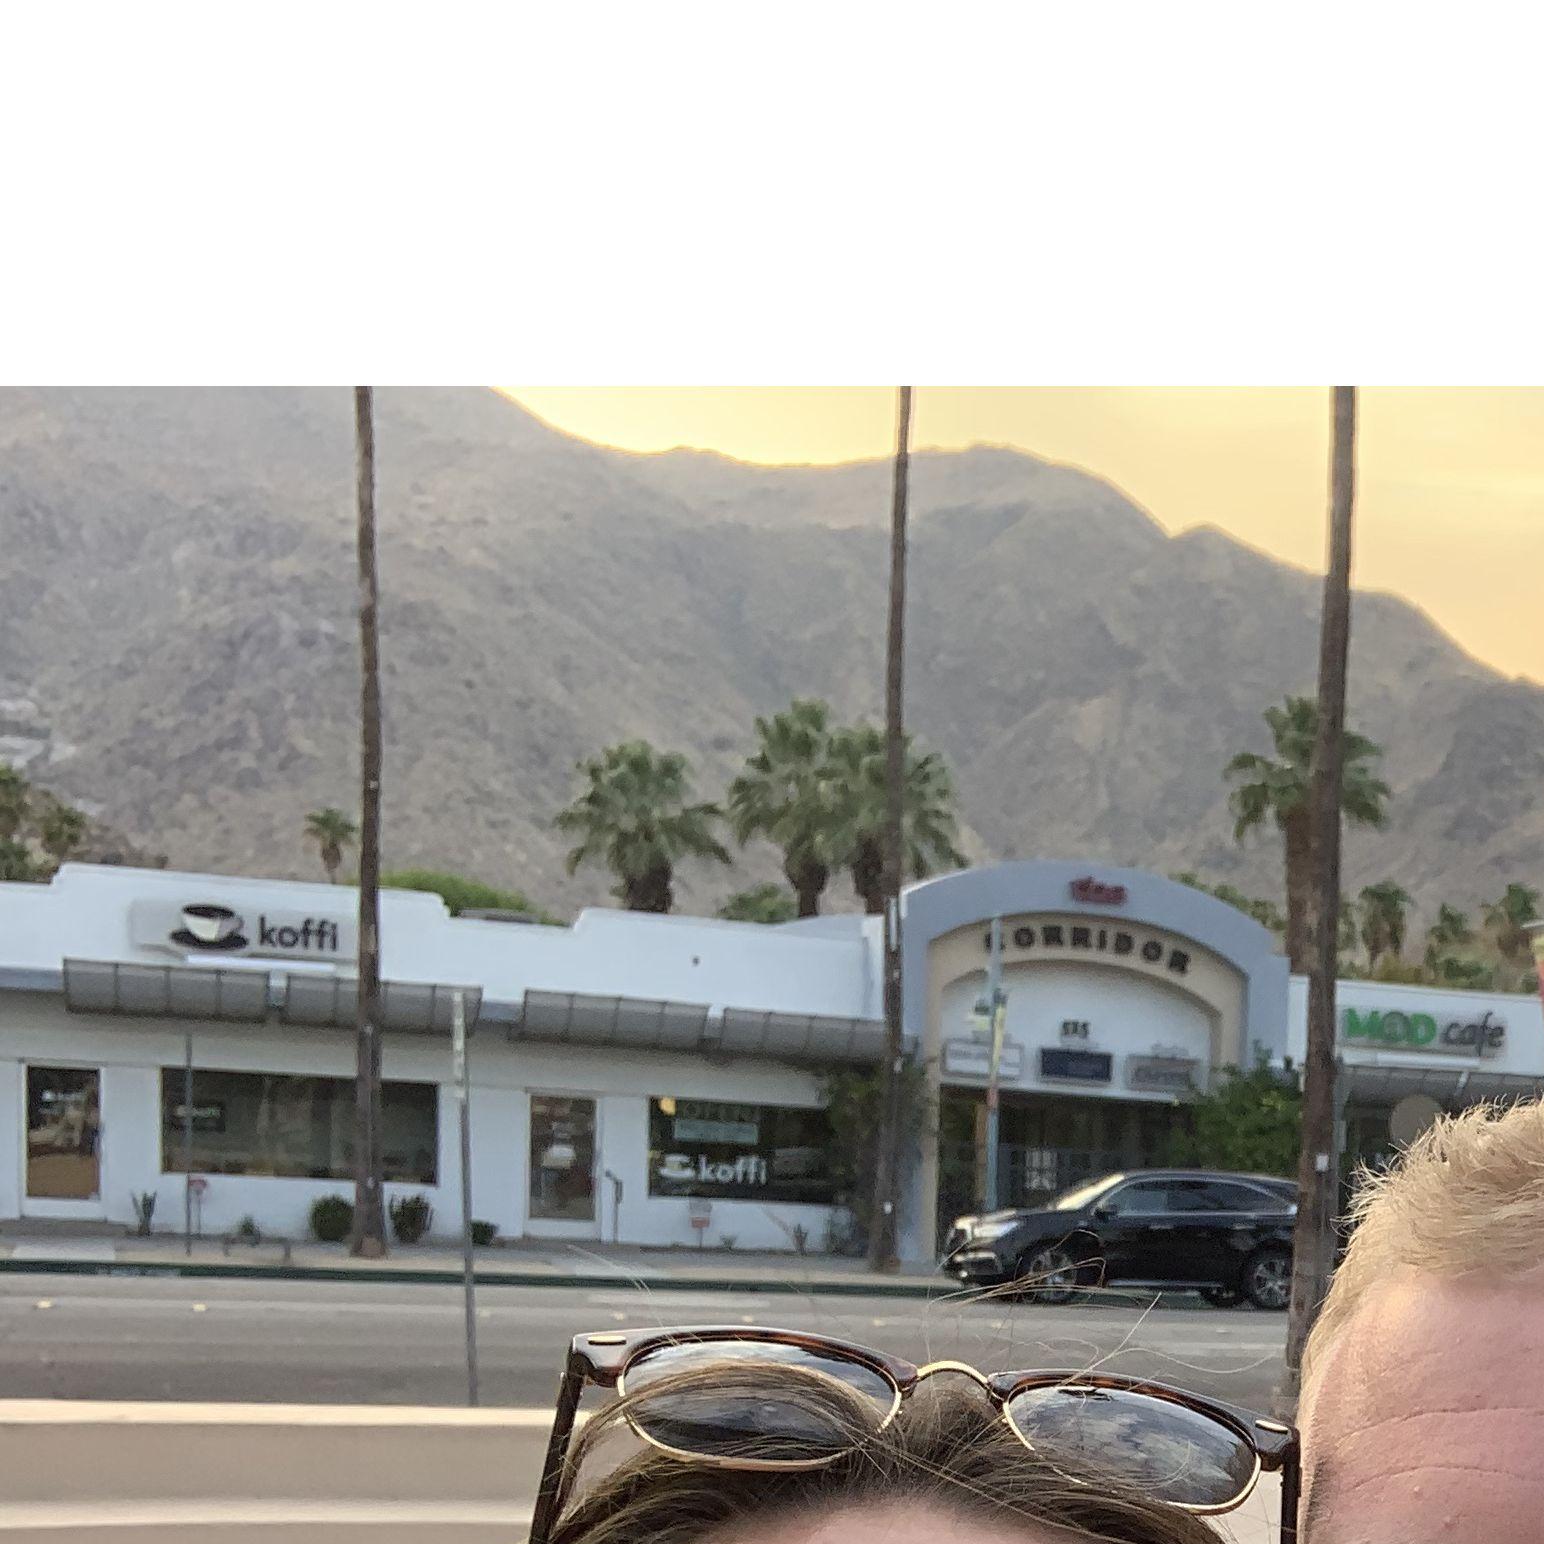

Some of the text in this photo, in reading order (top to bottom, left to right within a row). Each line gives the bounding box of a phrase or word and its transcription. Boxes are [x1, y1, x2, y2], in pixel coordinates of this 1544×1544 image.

[257, 913, 339, 952] koffi
[1343, 1007, 1505, 1057] MOD cafe
[698, 1153, 767, 1186] koffi
